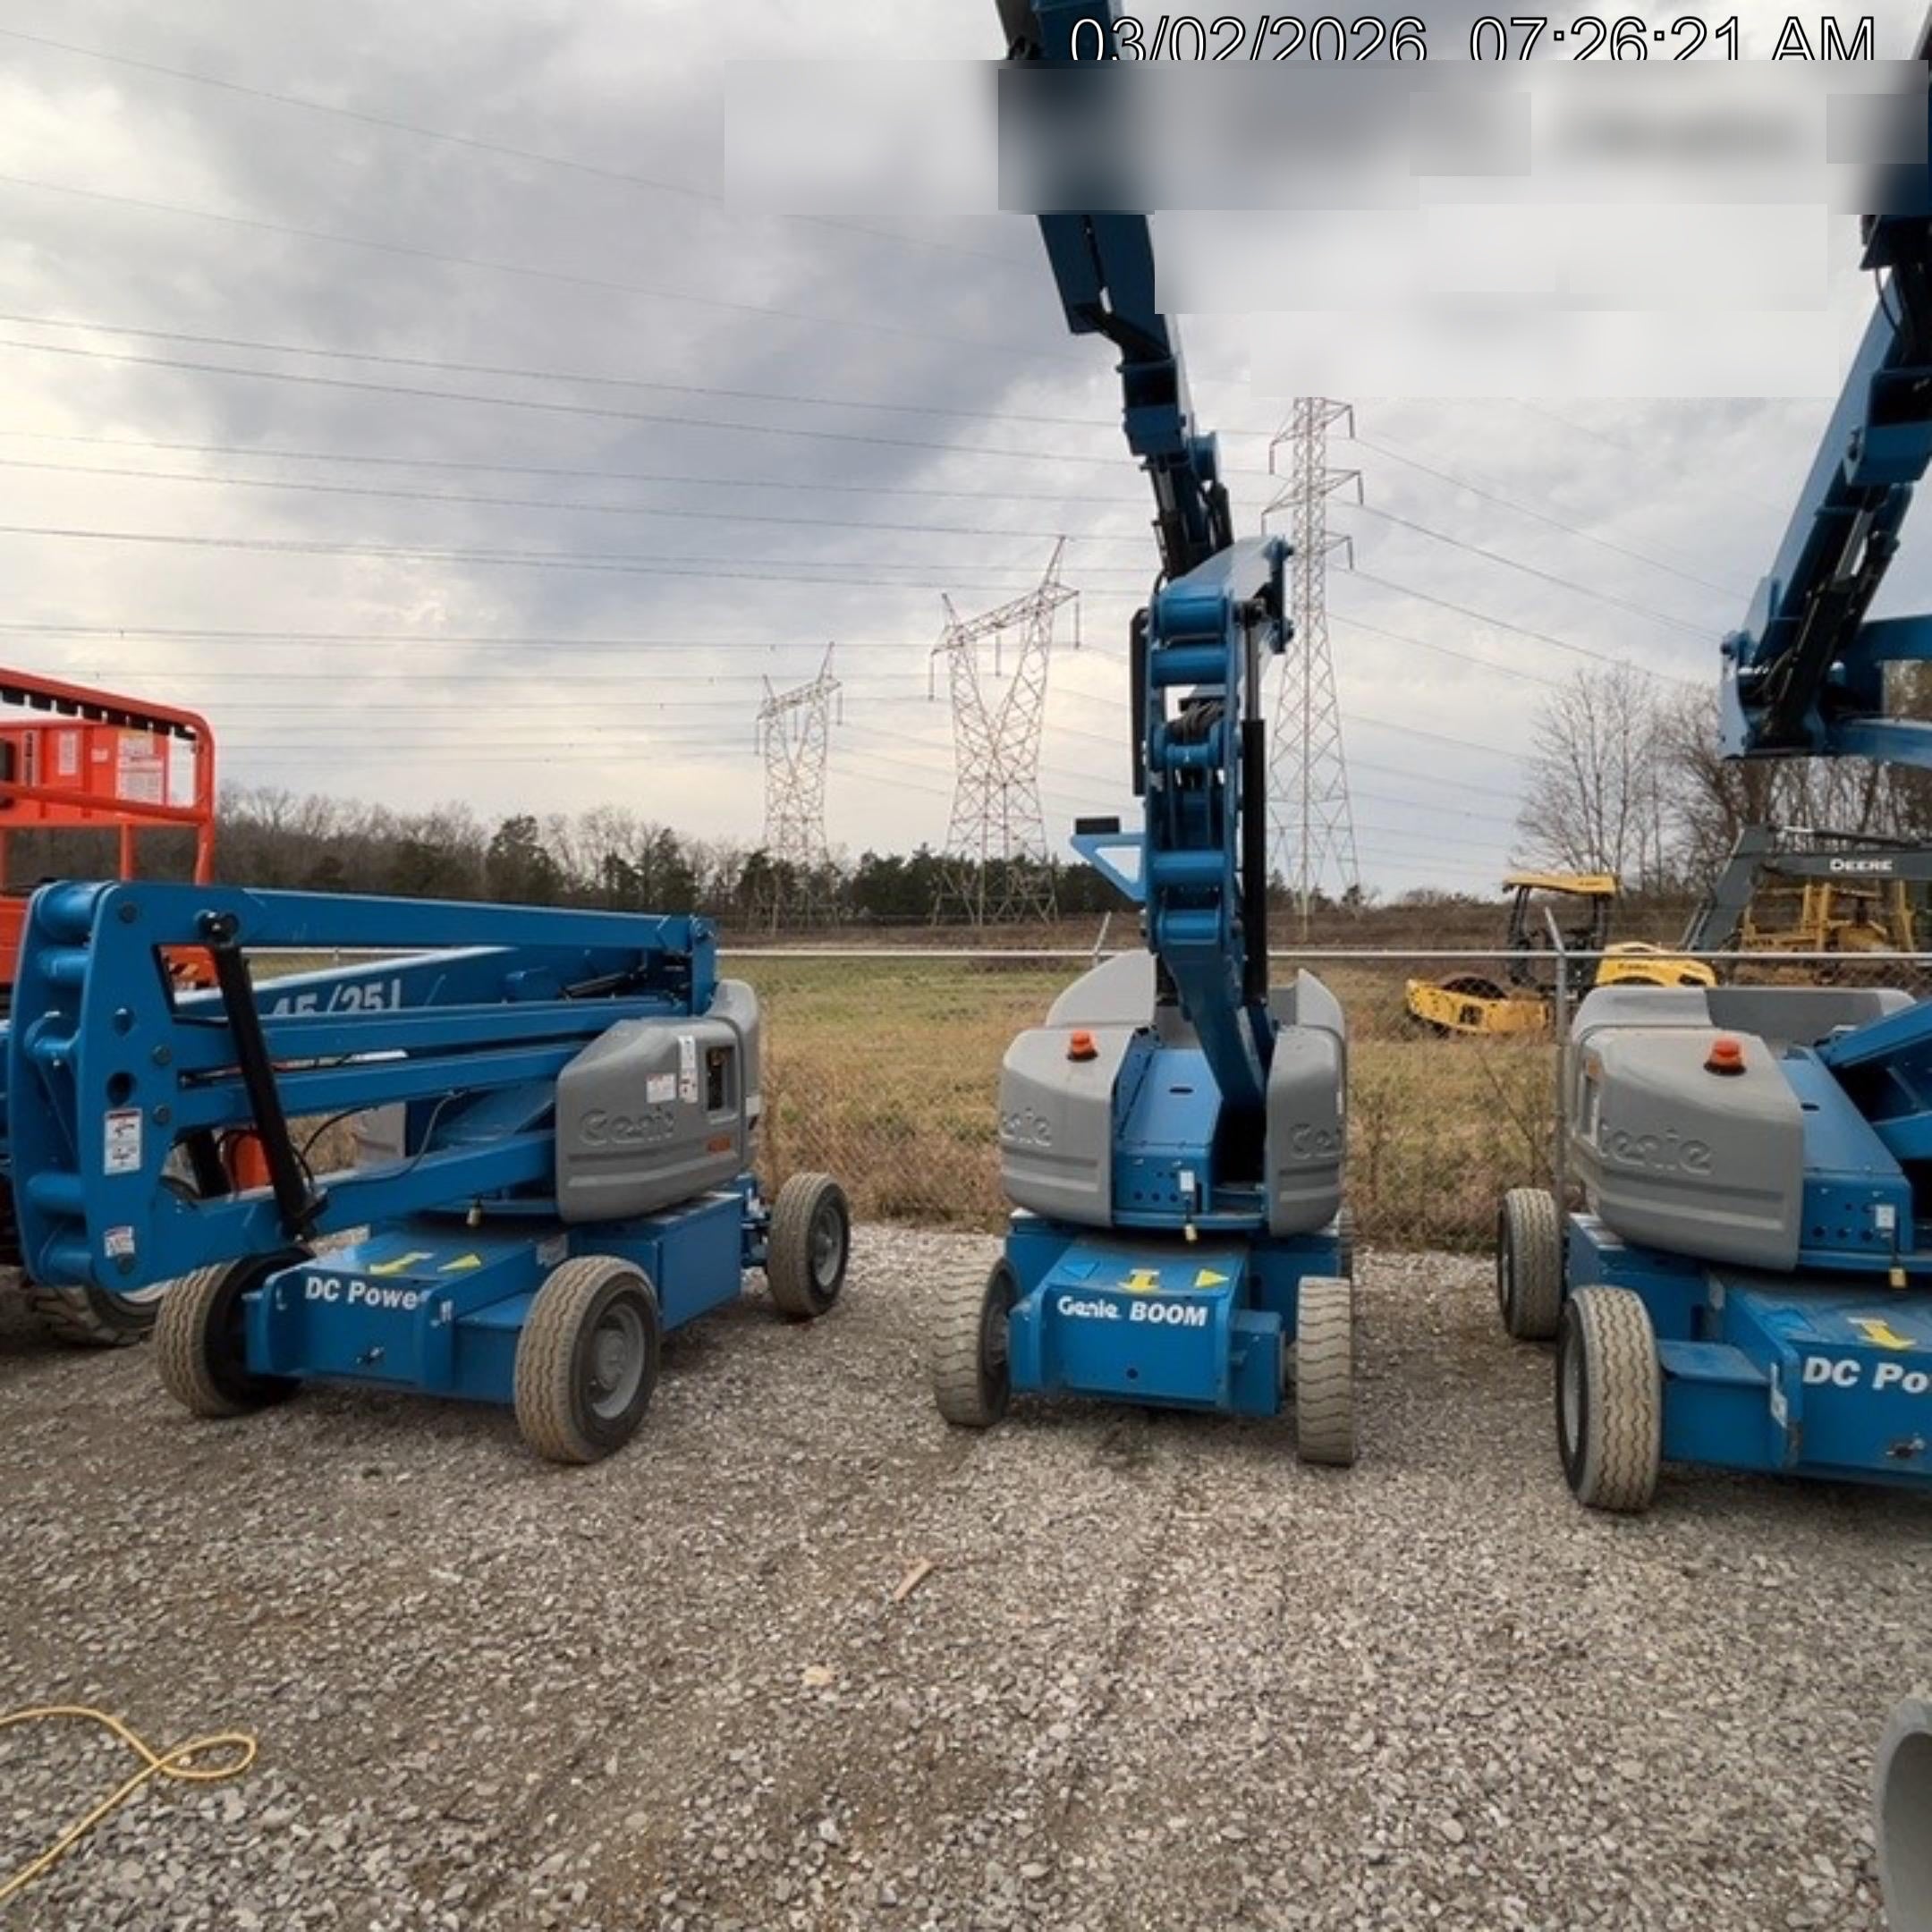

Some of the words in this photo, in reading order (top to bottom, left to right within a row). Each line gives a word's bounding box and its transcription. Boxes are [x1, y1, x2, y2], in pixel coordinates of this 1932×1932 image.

[1829, 859, 1893, 873] DEERE
[305, 1276, 341, 1301] DC
[1056, 1295, 1121, 1320] Genie
[1129, 1301, 1208, 1326] BOOM
[1802, 1356, 1861, 1388] DC
